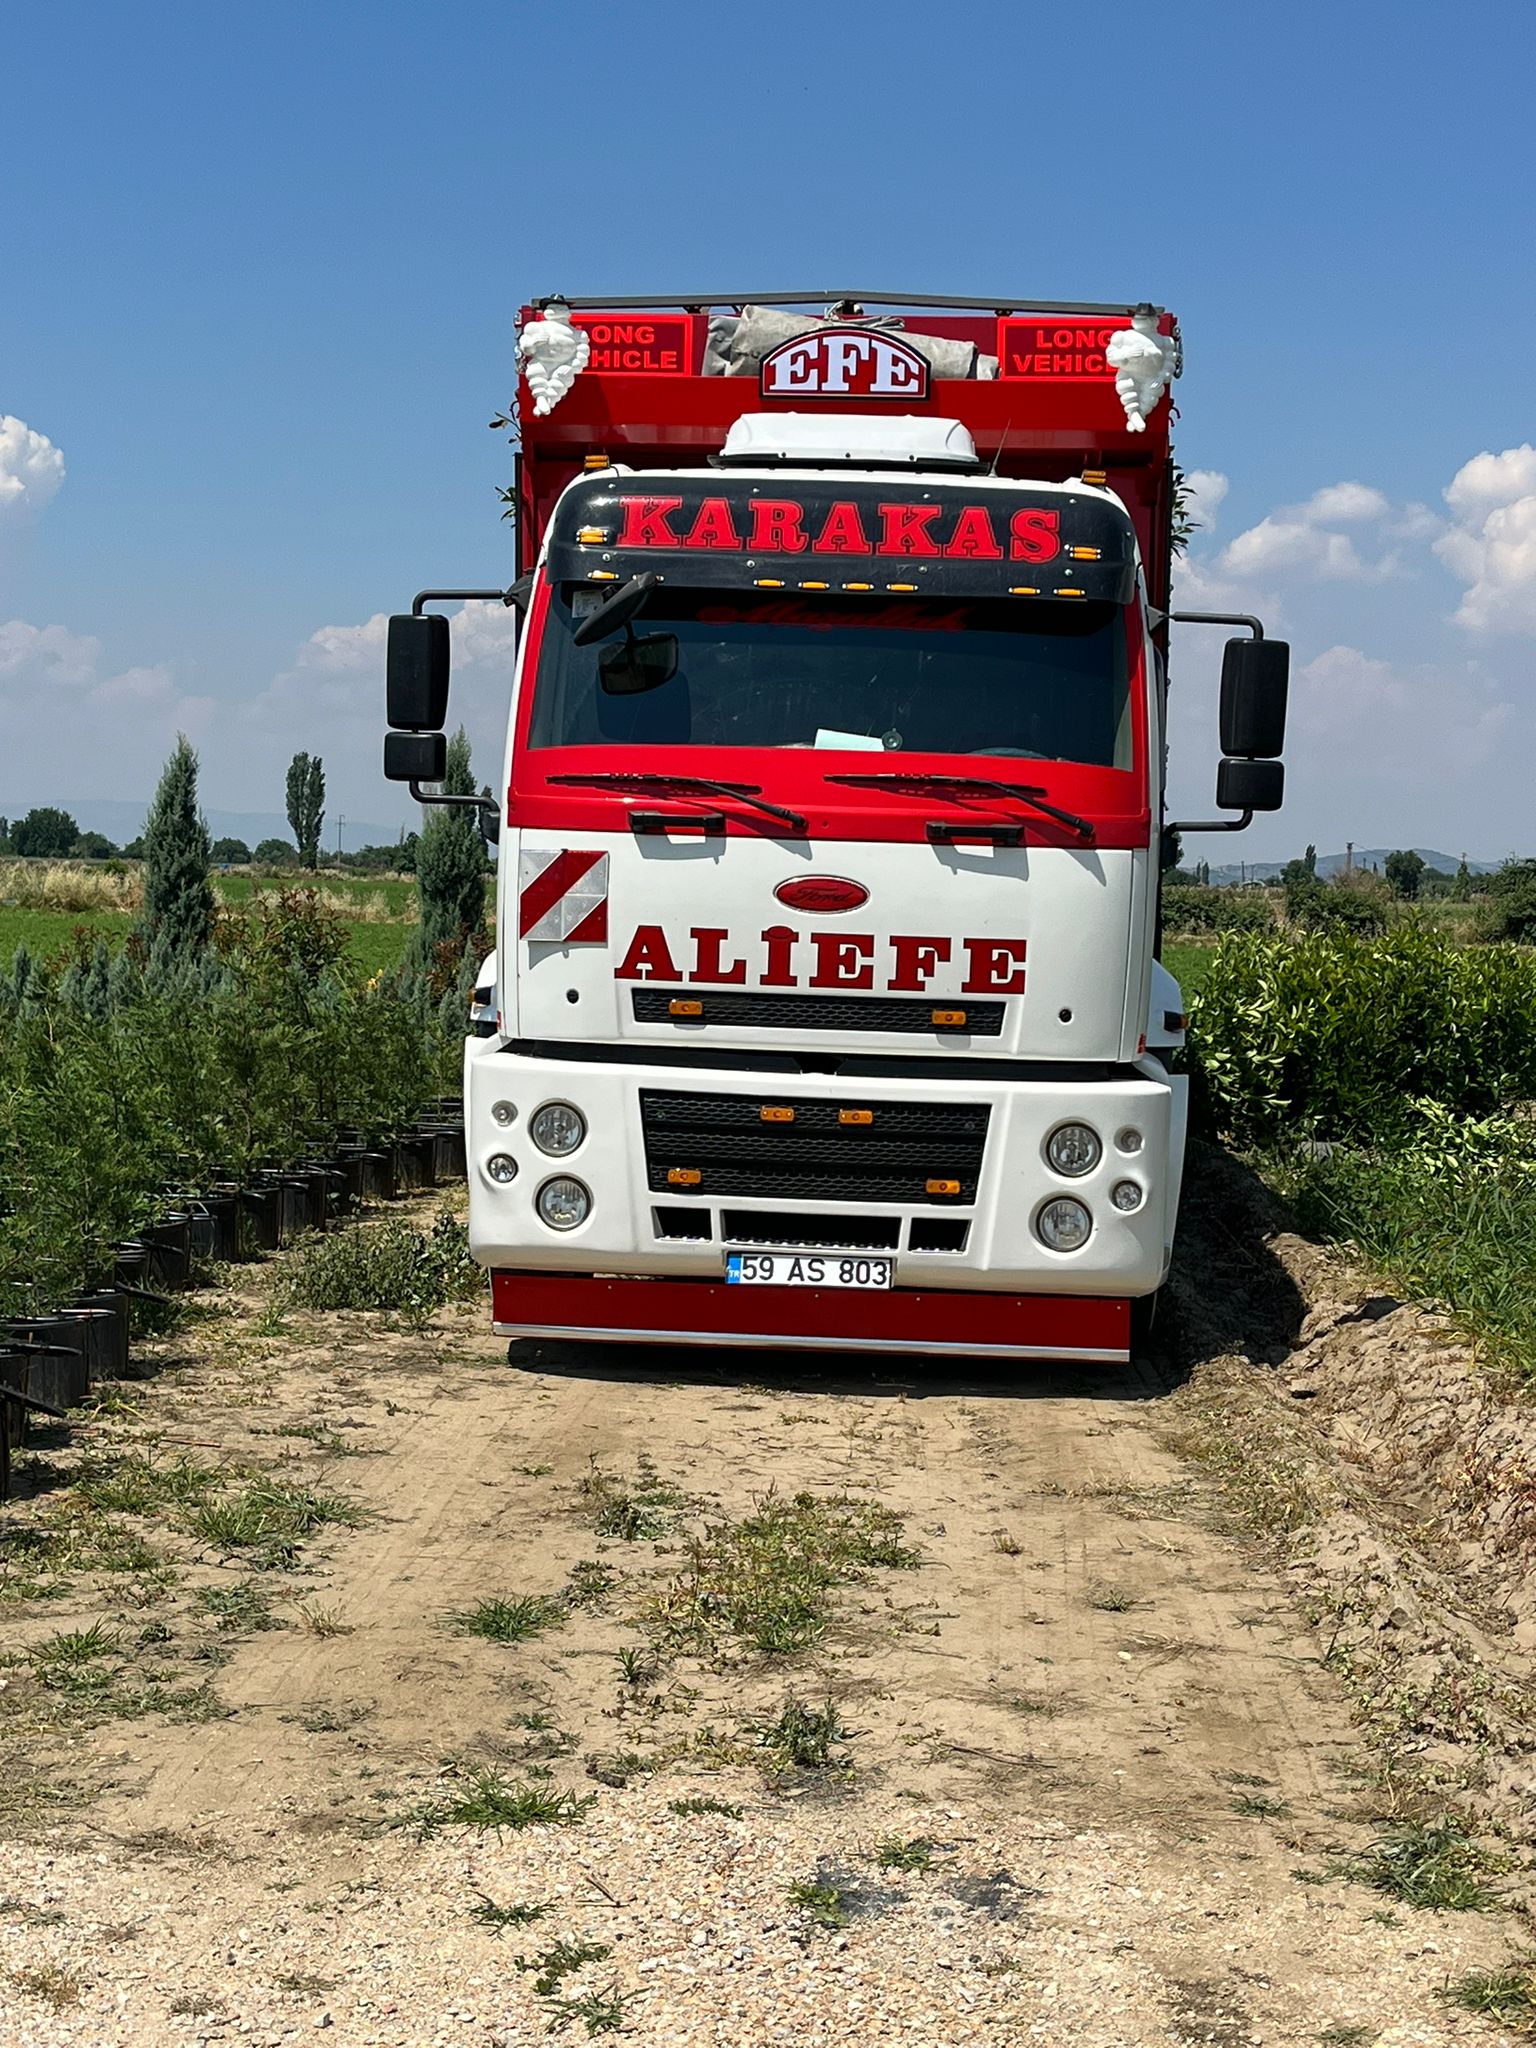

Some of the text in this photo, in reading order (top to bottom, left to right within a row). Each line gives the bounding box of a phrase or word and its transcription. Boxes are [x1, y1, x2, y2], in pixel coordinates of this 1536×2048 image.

[575, 325, 655, 344] ONG
[591, 350, 678, 369] HICLE
[769, 335, 920, 393] EFE
[614, 495, 1062, 565] KARAKAS
[789, 886, 854, 902] Ford
[728, 1269, 740, 1278] TR
[742, 1256, 888, 1286] 59 AS 803
